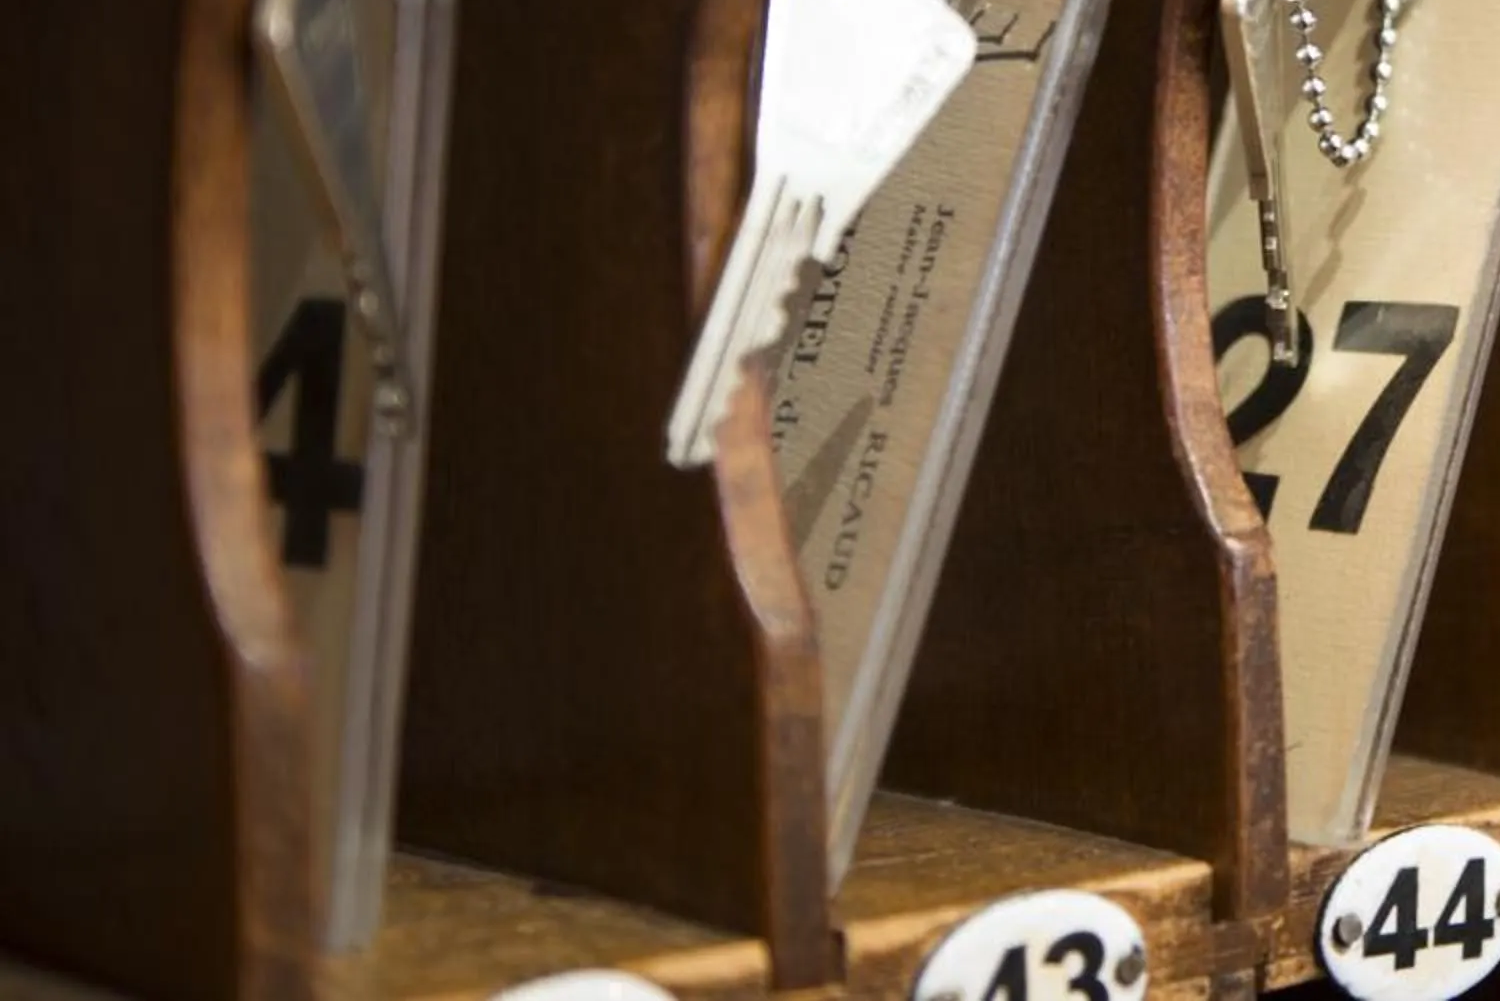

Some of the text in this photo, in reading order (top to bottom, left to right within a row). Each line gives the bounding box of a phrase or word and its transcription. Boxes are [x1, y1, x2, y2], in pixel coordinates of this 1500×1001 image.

[788, 210, 863, 381] OTEL
[879, 204, 954, 407] Jean-Jacques
[1212, 295, 1460, 535] 27
[825, 432, 888, 590] RICAUD
[1363, 858, 1495, 970] 44
